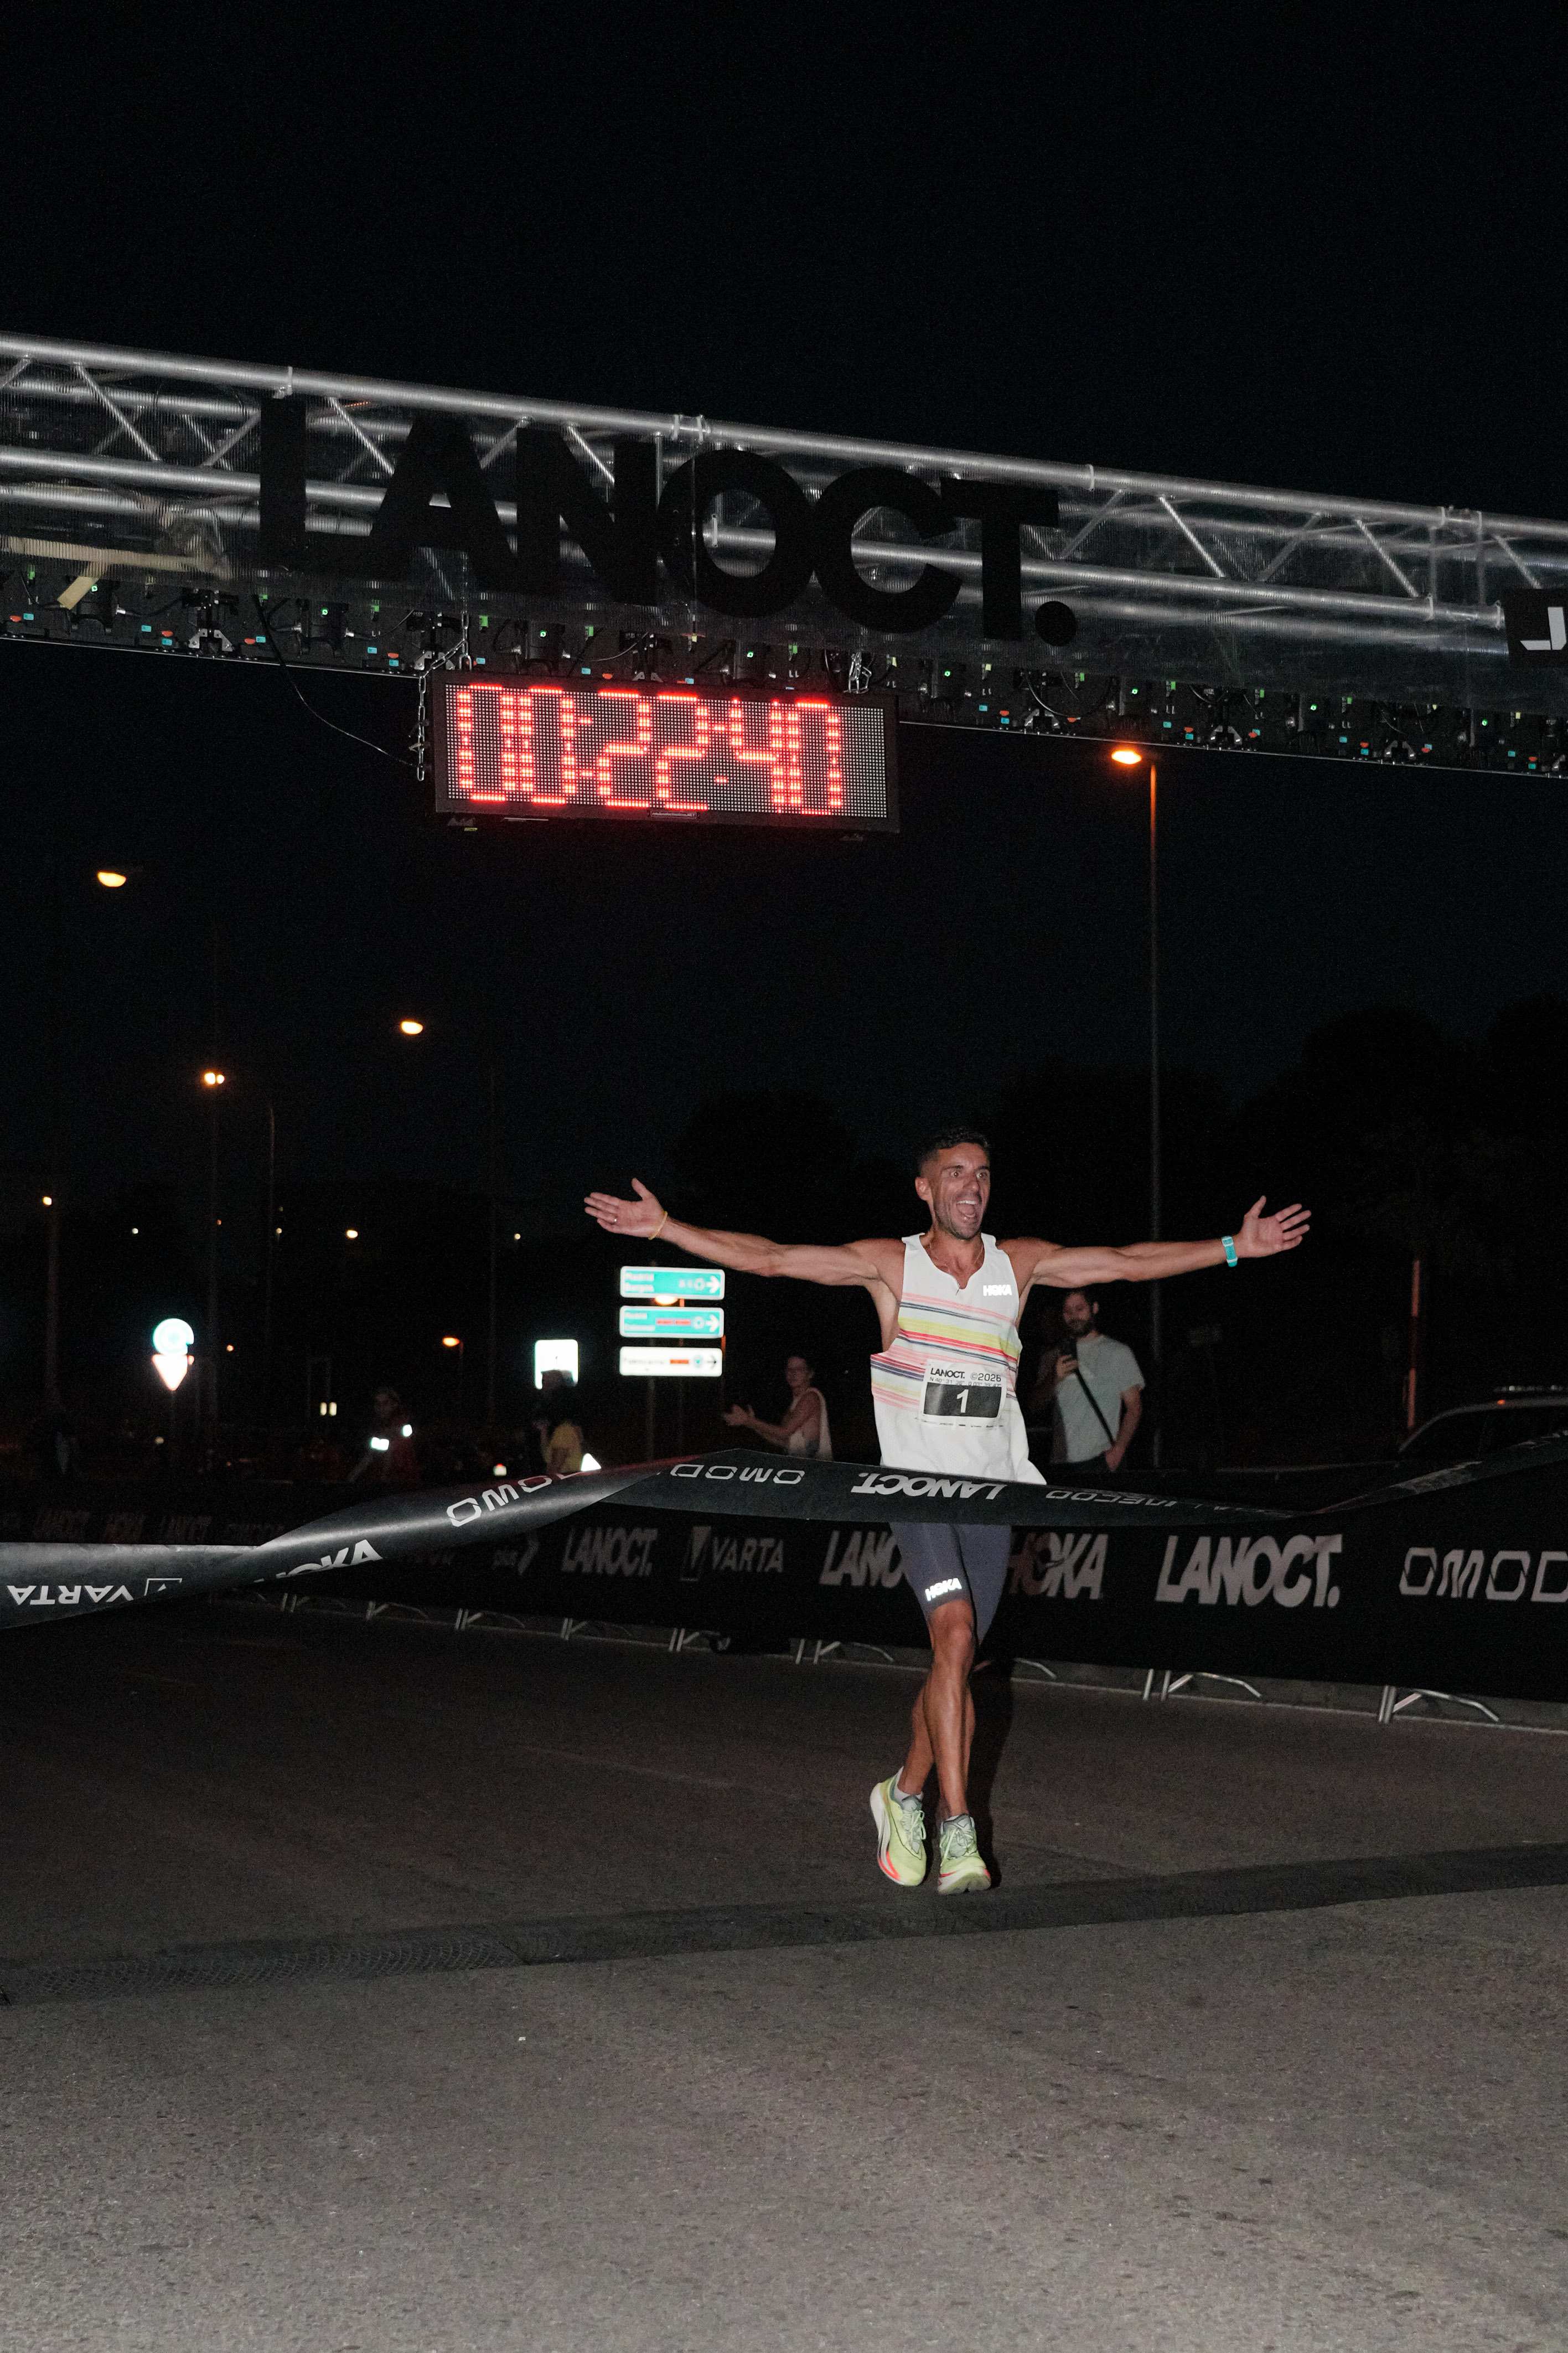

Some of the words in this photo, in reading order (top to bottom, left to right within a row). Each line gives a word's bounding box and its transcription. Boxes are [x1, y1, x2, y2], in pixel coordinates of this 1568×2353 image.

[260, 396, 1077, 647] LANOCT.
[458, 684, 844, 814] 00:22:40
[930, 1368, 965, 1379] LANOCT.
[956, 1389, 969, 1413] 1
[657, 1464, 805, 1484] OMOD
[851, 1473, 1008, 1500] LANOCT.
[446, 1470, 580, 1527] OMO
[561, 1526, 659, 1577] LANOCT.
[712, 1536, 784, 1573] VARTA
[1155, 1534, 1343, 1608] LANOCT.
[7, 1585, 134, 1605] VARTA
